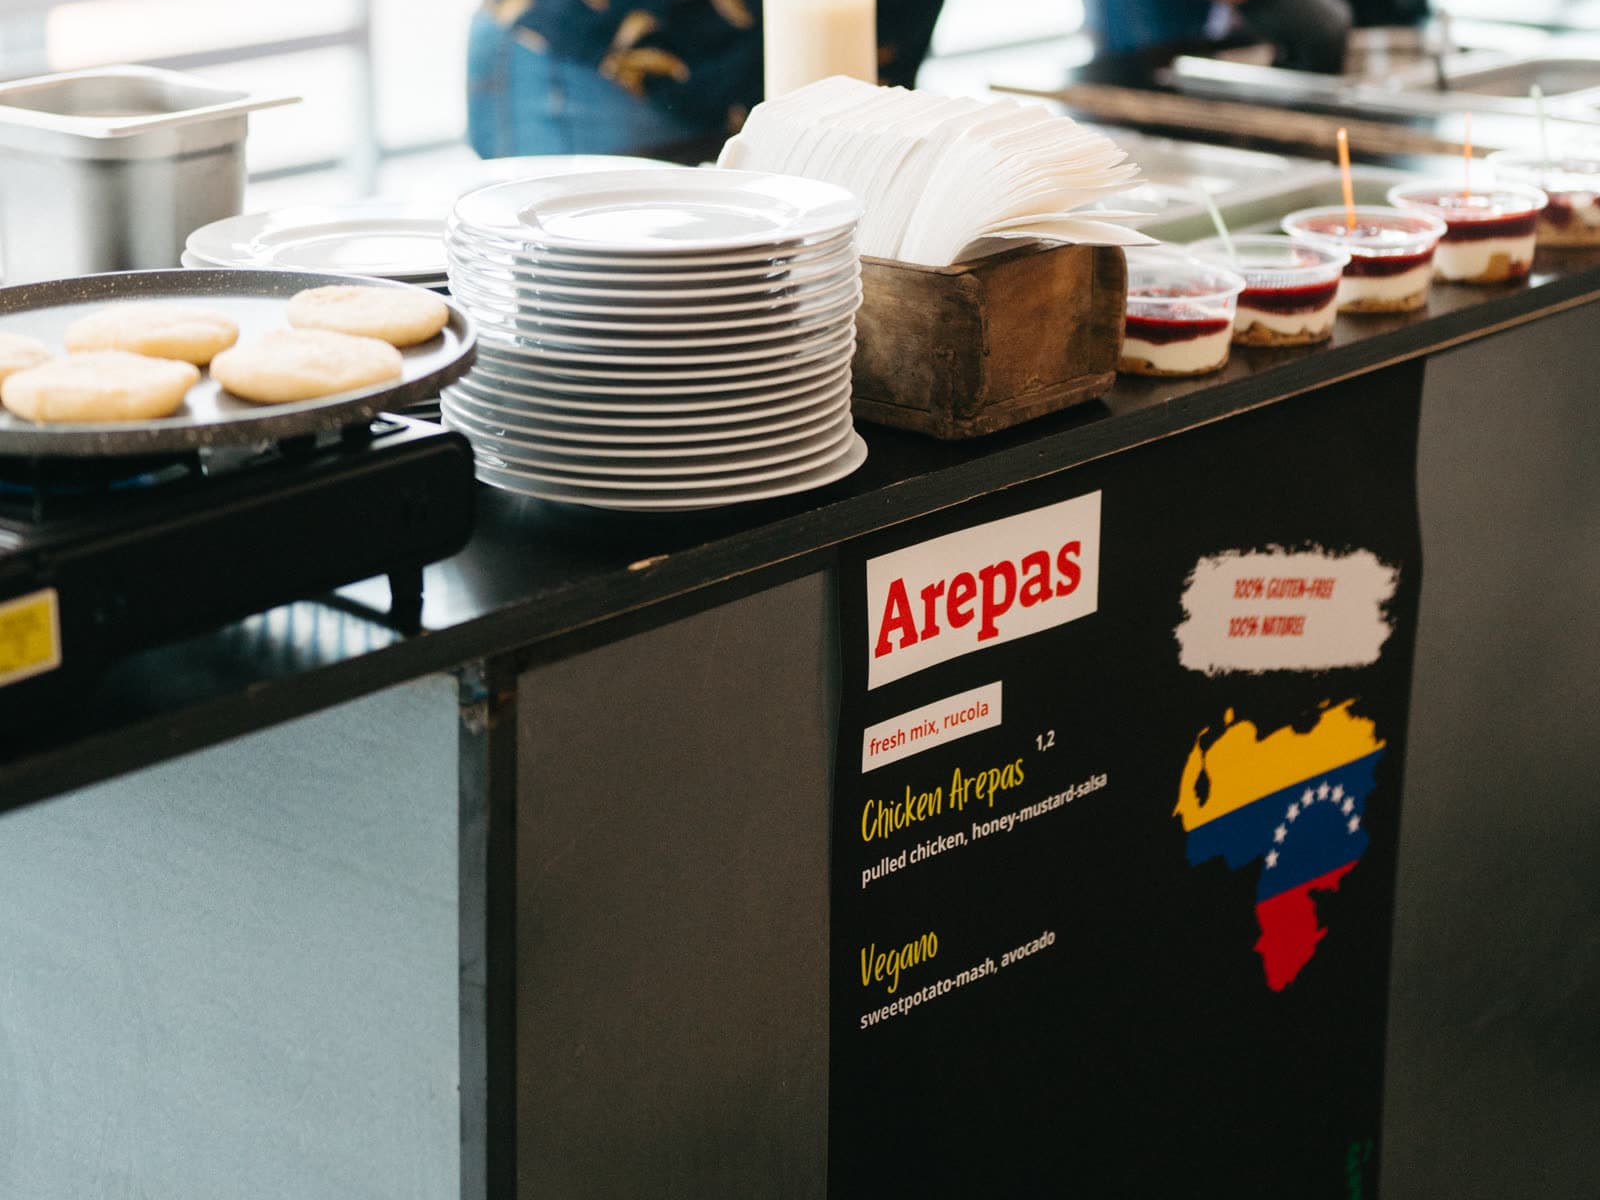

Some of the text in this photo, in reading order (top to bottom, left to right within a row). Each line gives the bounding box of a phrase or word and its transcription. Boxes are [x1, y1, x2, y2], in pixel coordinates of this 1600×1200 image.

[874, 540, 1081, 658] Arepas
[1267, 577, 1337, 599] GLUTEN-FREE
[869, 701, 989, 757] fresh mix, rucola
[861, 729, 1056, 842] Chicken Arepas 1,2
[861, 772, 1108, 889] pulled chicken, honey-mustard-salsa
[860, 931, 938, 994] Vegano
[860, 930, 1056, 1029] sweetpotato-mash, avocado
